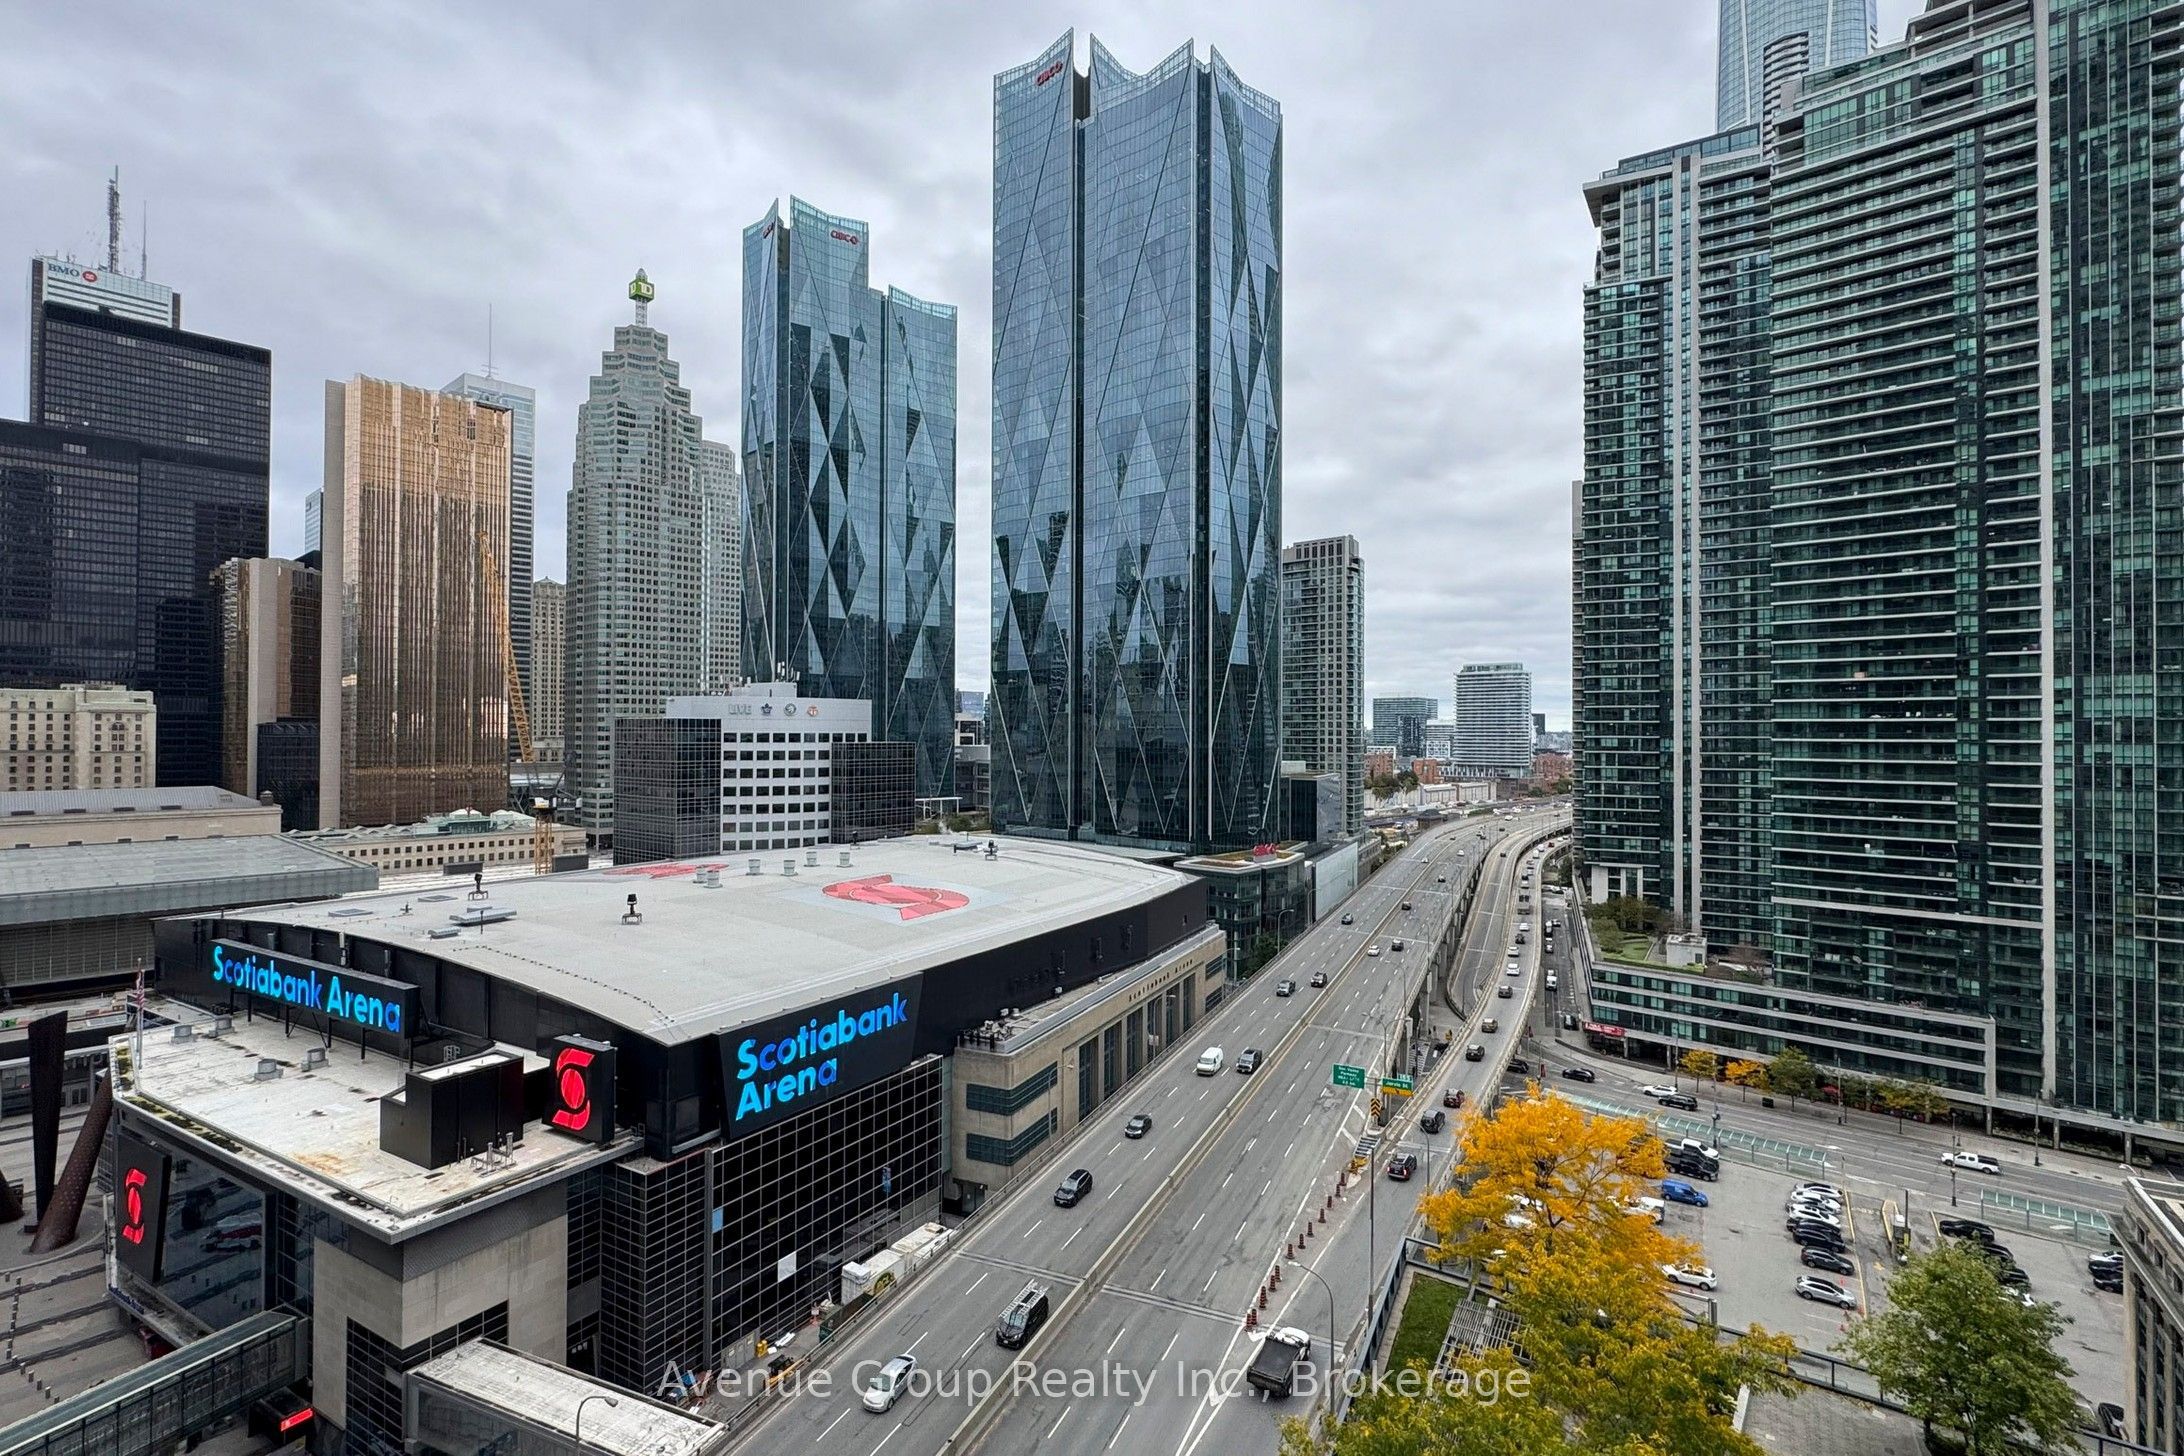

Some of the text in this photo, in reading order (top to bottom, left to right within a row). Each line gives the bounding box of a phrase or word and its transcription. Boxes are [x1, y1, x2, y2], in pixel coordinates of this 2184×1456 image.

[830, 229, 851, 242] CIBC
[48, 263, 80, 277] BMO
[638, 281, 653, 295] TD
[214, 945, 400, 1032] Scotiabank Arena
[737, 992, 907, 1080] Scotiabank
[735, 1058, 838, 1121] Arena
